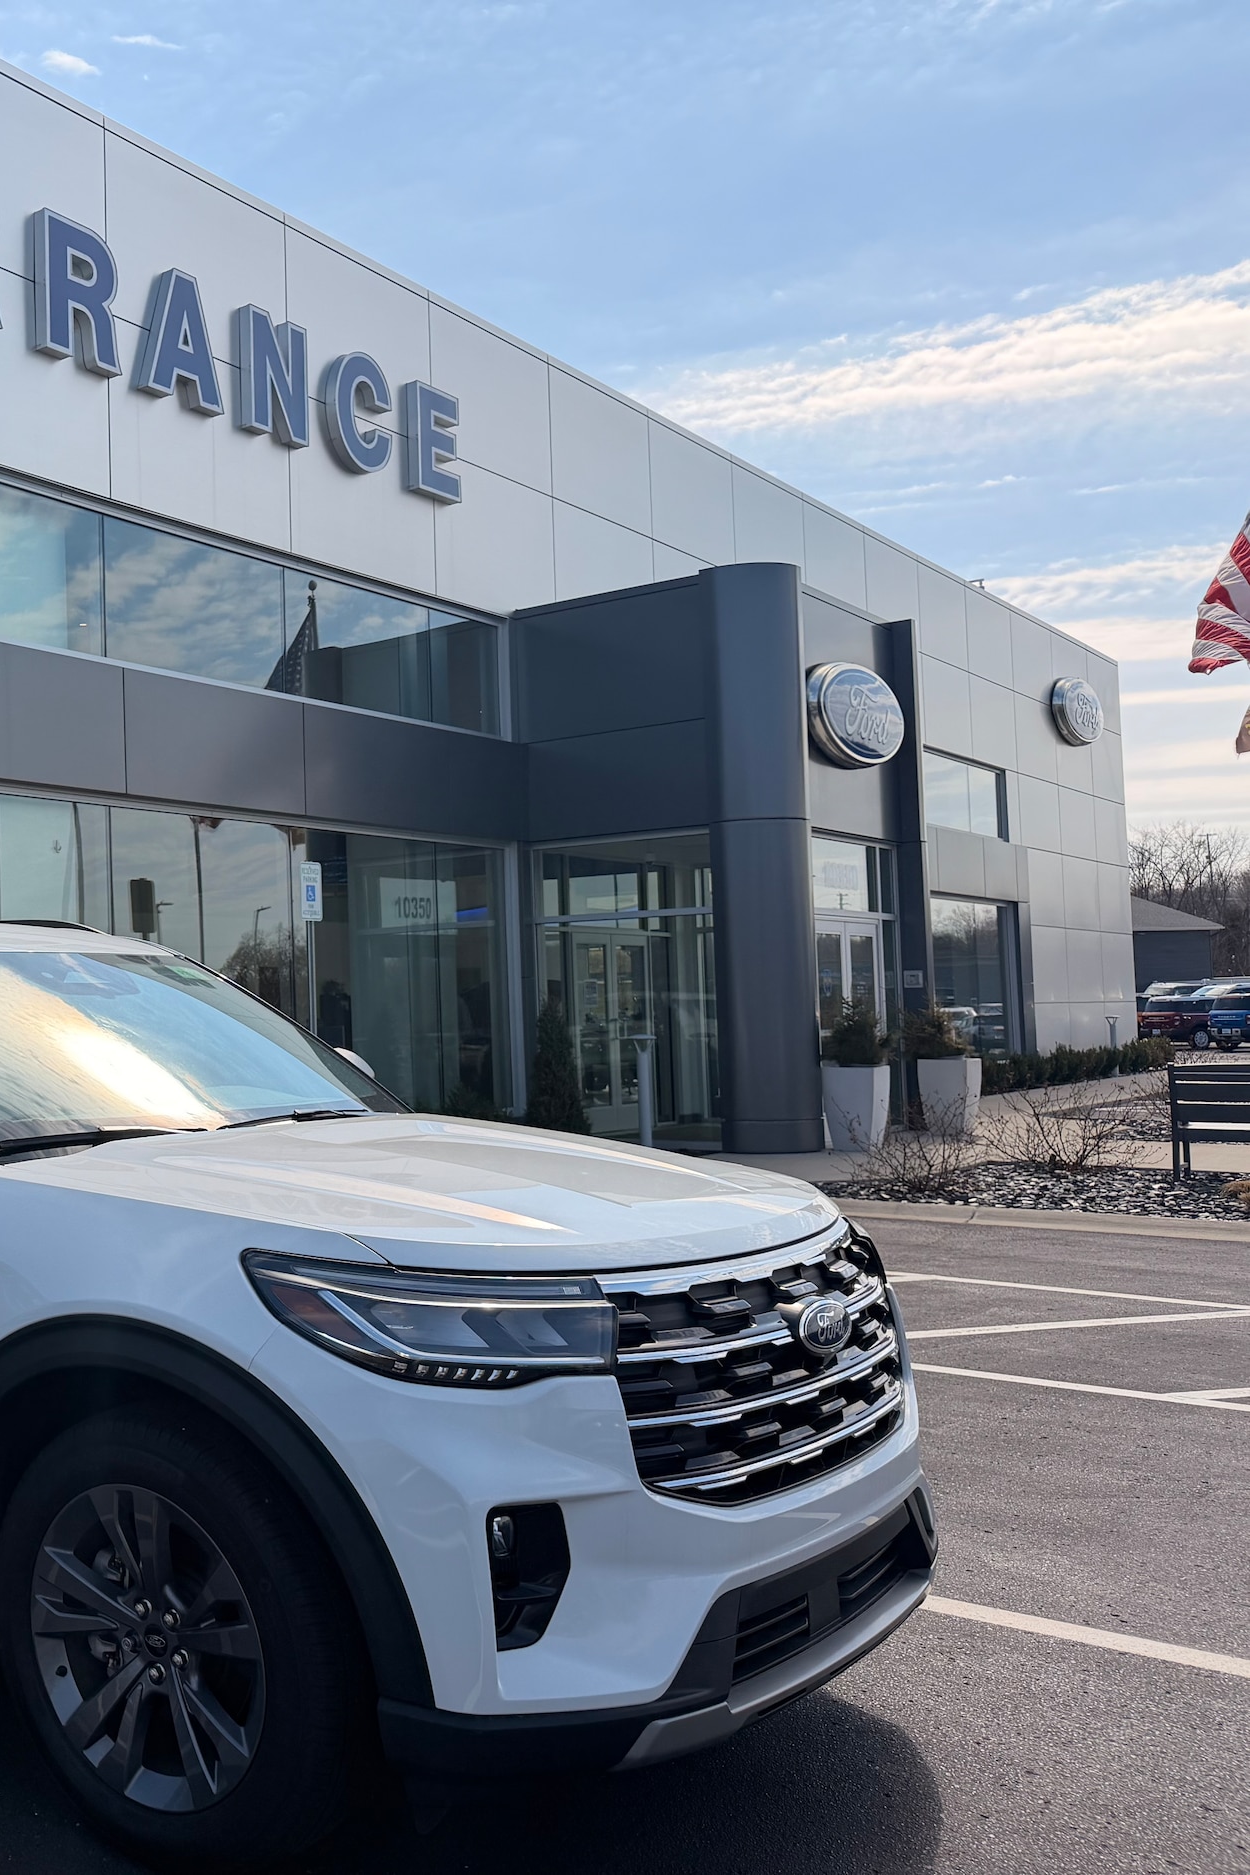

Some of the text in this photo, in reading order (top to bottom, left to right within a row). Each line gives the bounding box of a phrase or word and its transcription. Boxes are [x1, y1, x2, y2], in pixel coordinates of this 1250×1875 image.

[845, 684, 890, 745] Ford
[395, 896, 432, 920] 10350
[817, 1310, 847, 1343] Ford
